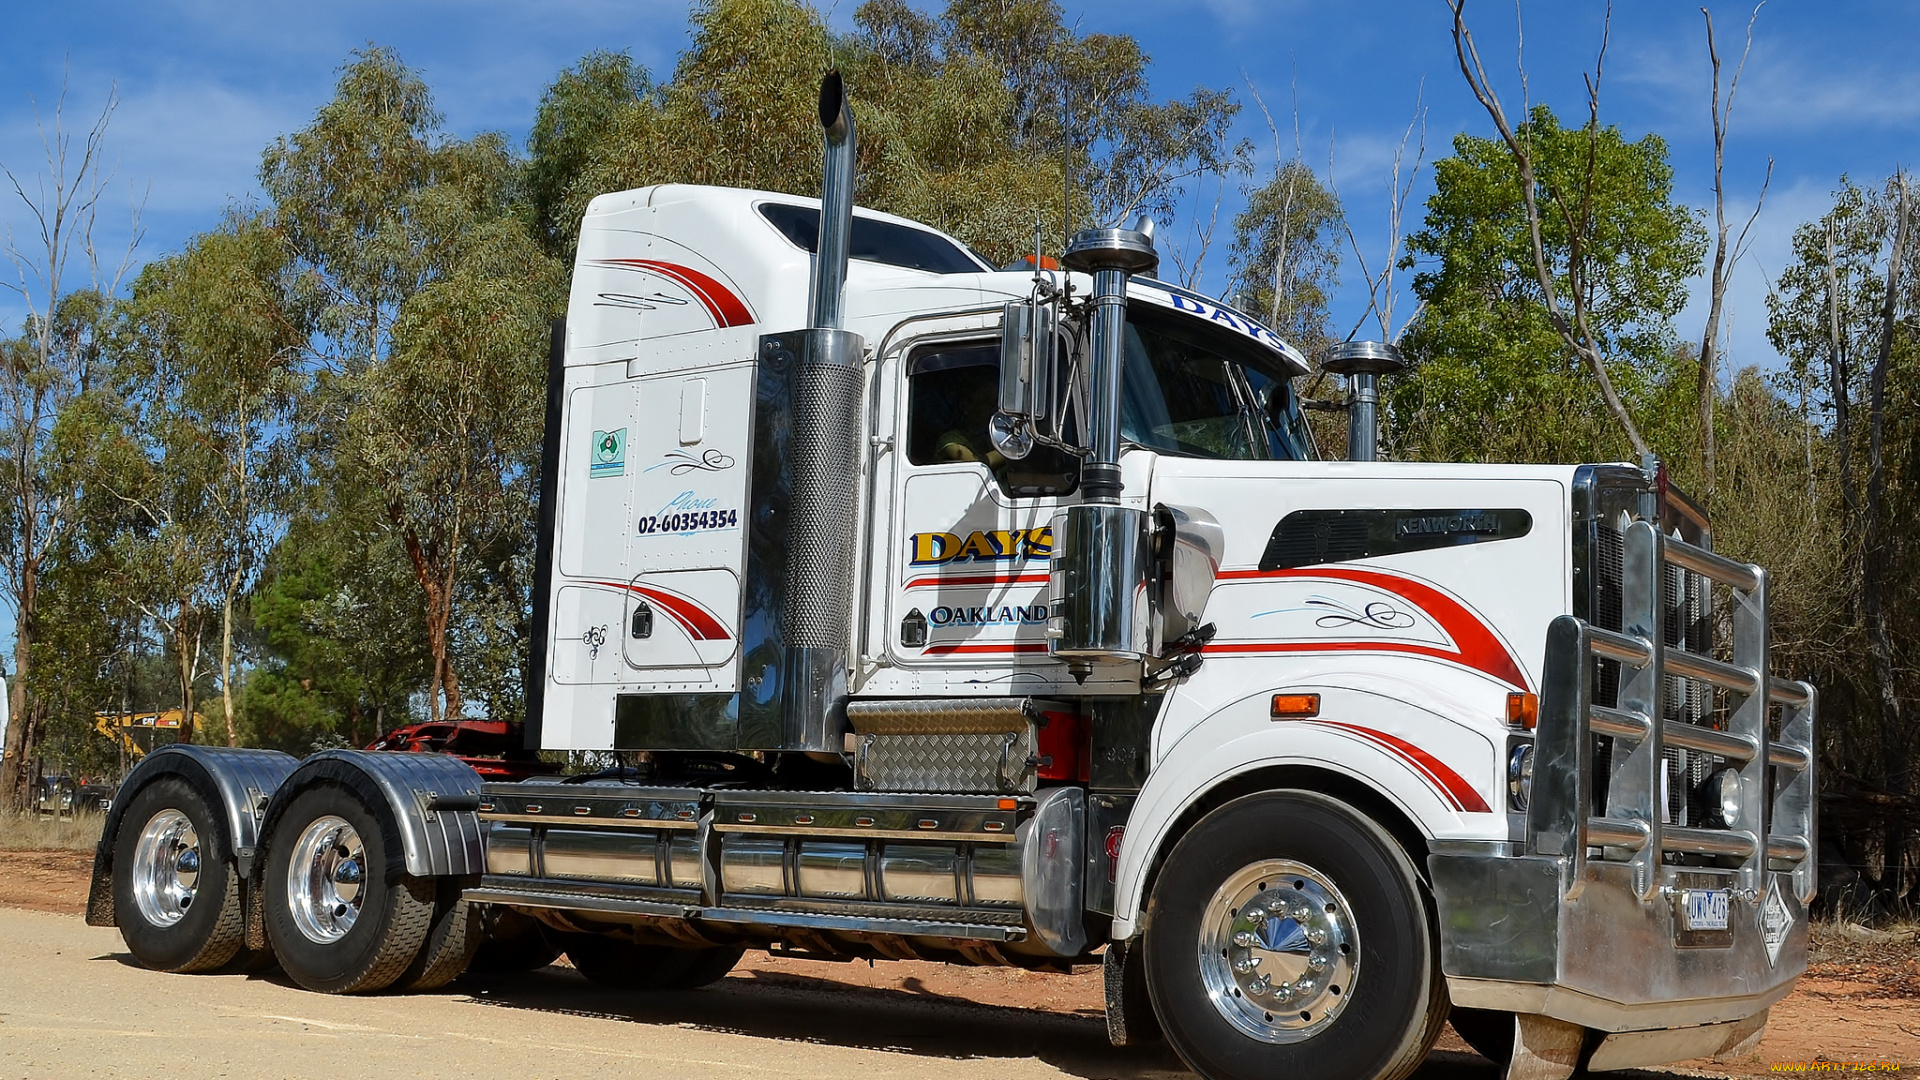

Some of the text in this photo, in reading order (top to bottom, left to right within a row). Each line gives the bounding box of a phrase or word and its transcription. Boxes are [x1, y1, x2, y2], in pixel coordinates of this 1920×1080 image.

[1170, 294, 1286, 351] DAYS
[656, 490, 718, 517] Phone
[638, 509, 738, 534] 02-60354354
[1396, 515, 1498, 534] KENWORTH
[929, 605, 1049, 627] OAKLAND
[142, 717, 156, 726] CAT
